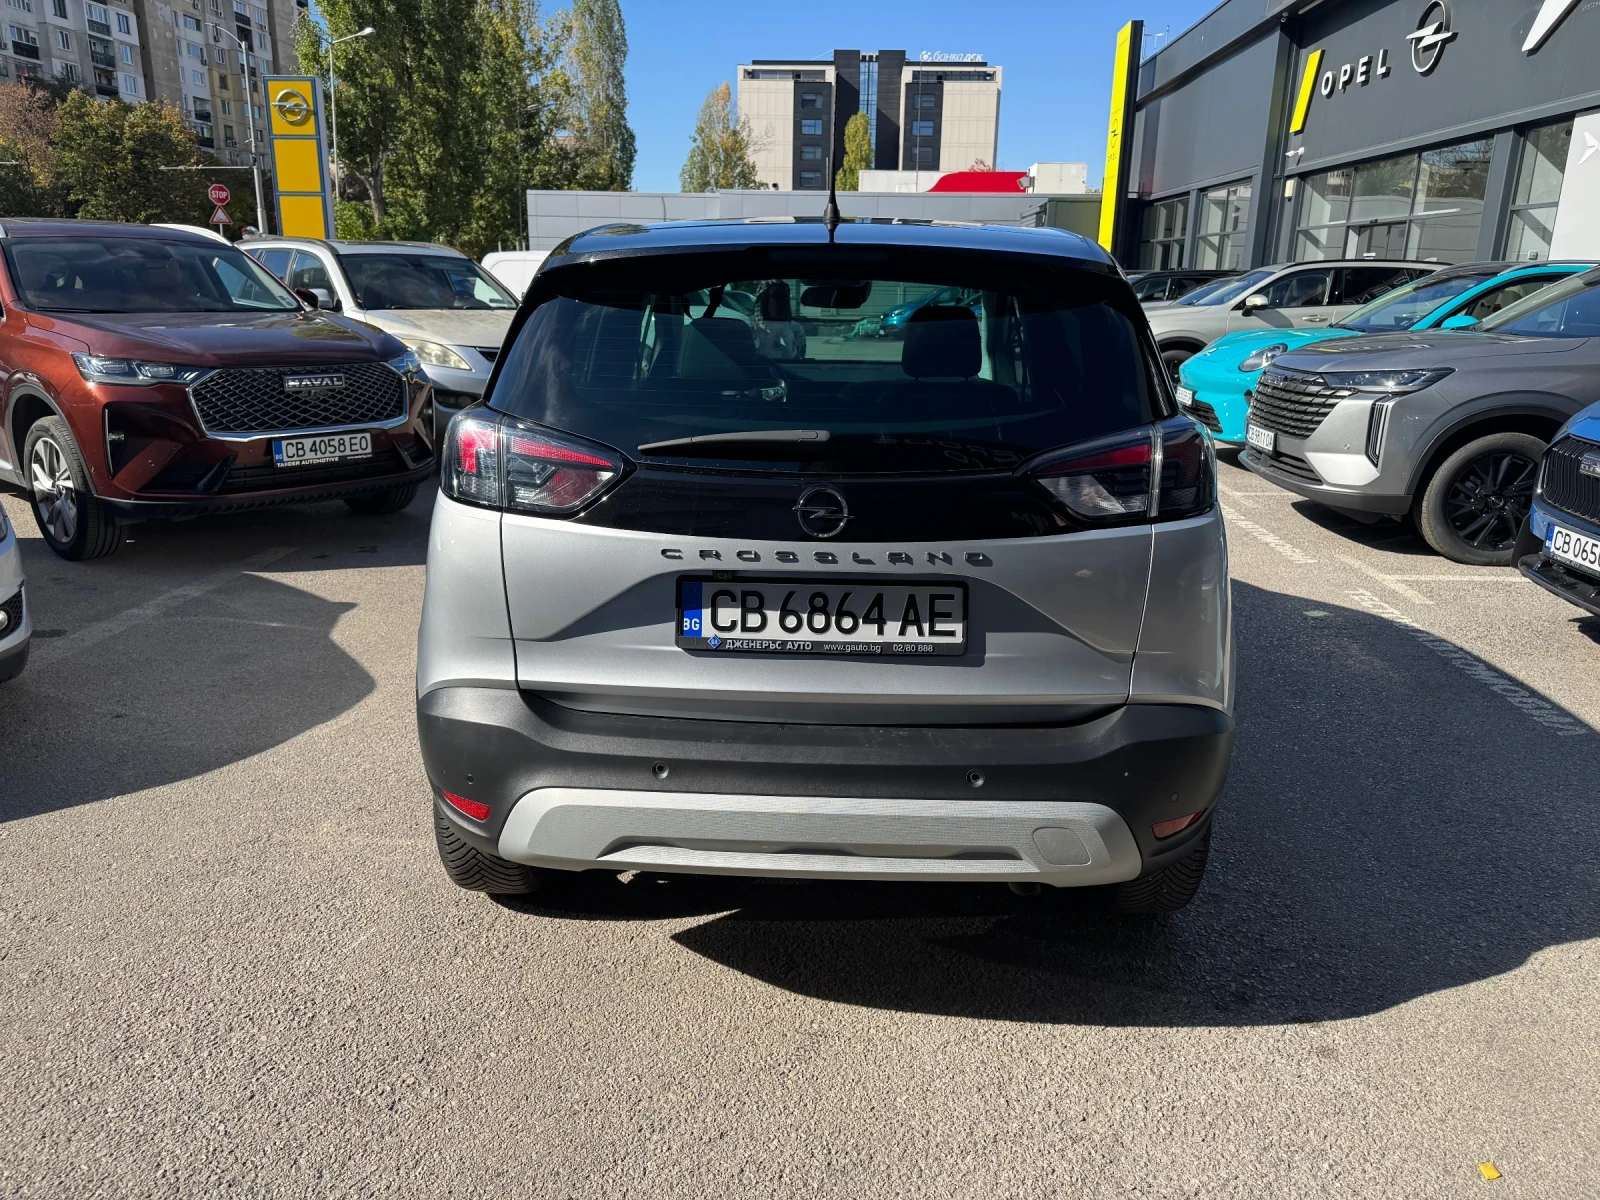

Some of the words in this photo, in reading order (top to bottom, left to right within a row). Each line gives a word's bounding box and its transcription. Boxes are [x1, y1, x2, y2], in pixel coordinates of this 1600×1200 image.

[933, 50, 963, 62] банка
[1321, 49, 1389, 96] OPEL
[211, 190, 227, 199] STOP
[288, 377, 343, 388] HAVAL
[285, 441, 306, 459] CB
[309, 437, 346, 457] 4058
[349, 435, 369, 453] EO
[301, 456, 339, 465] AUTOMOTIVE
[1553, 530, 1572, 554] CB
[1573, 537, 1600, 567] 065
[661, 548, 988, 564] CROSSLAND
[710, 589, 768, 633] CB
[778, 590, 886, 635] 6864
[898, 593, 957, 638] AE
[683, 617, 700, 631] BG
[725, 639, 782, 650] ДЖЕНЕРЪС
[786, 641, 812, 650] АУТО
[823, 643, 881, 653] www.gauto.bg
[893, 643, 915, 652] 02/80
[918, 644, 934, 652] 888
